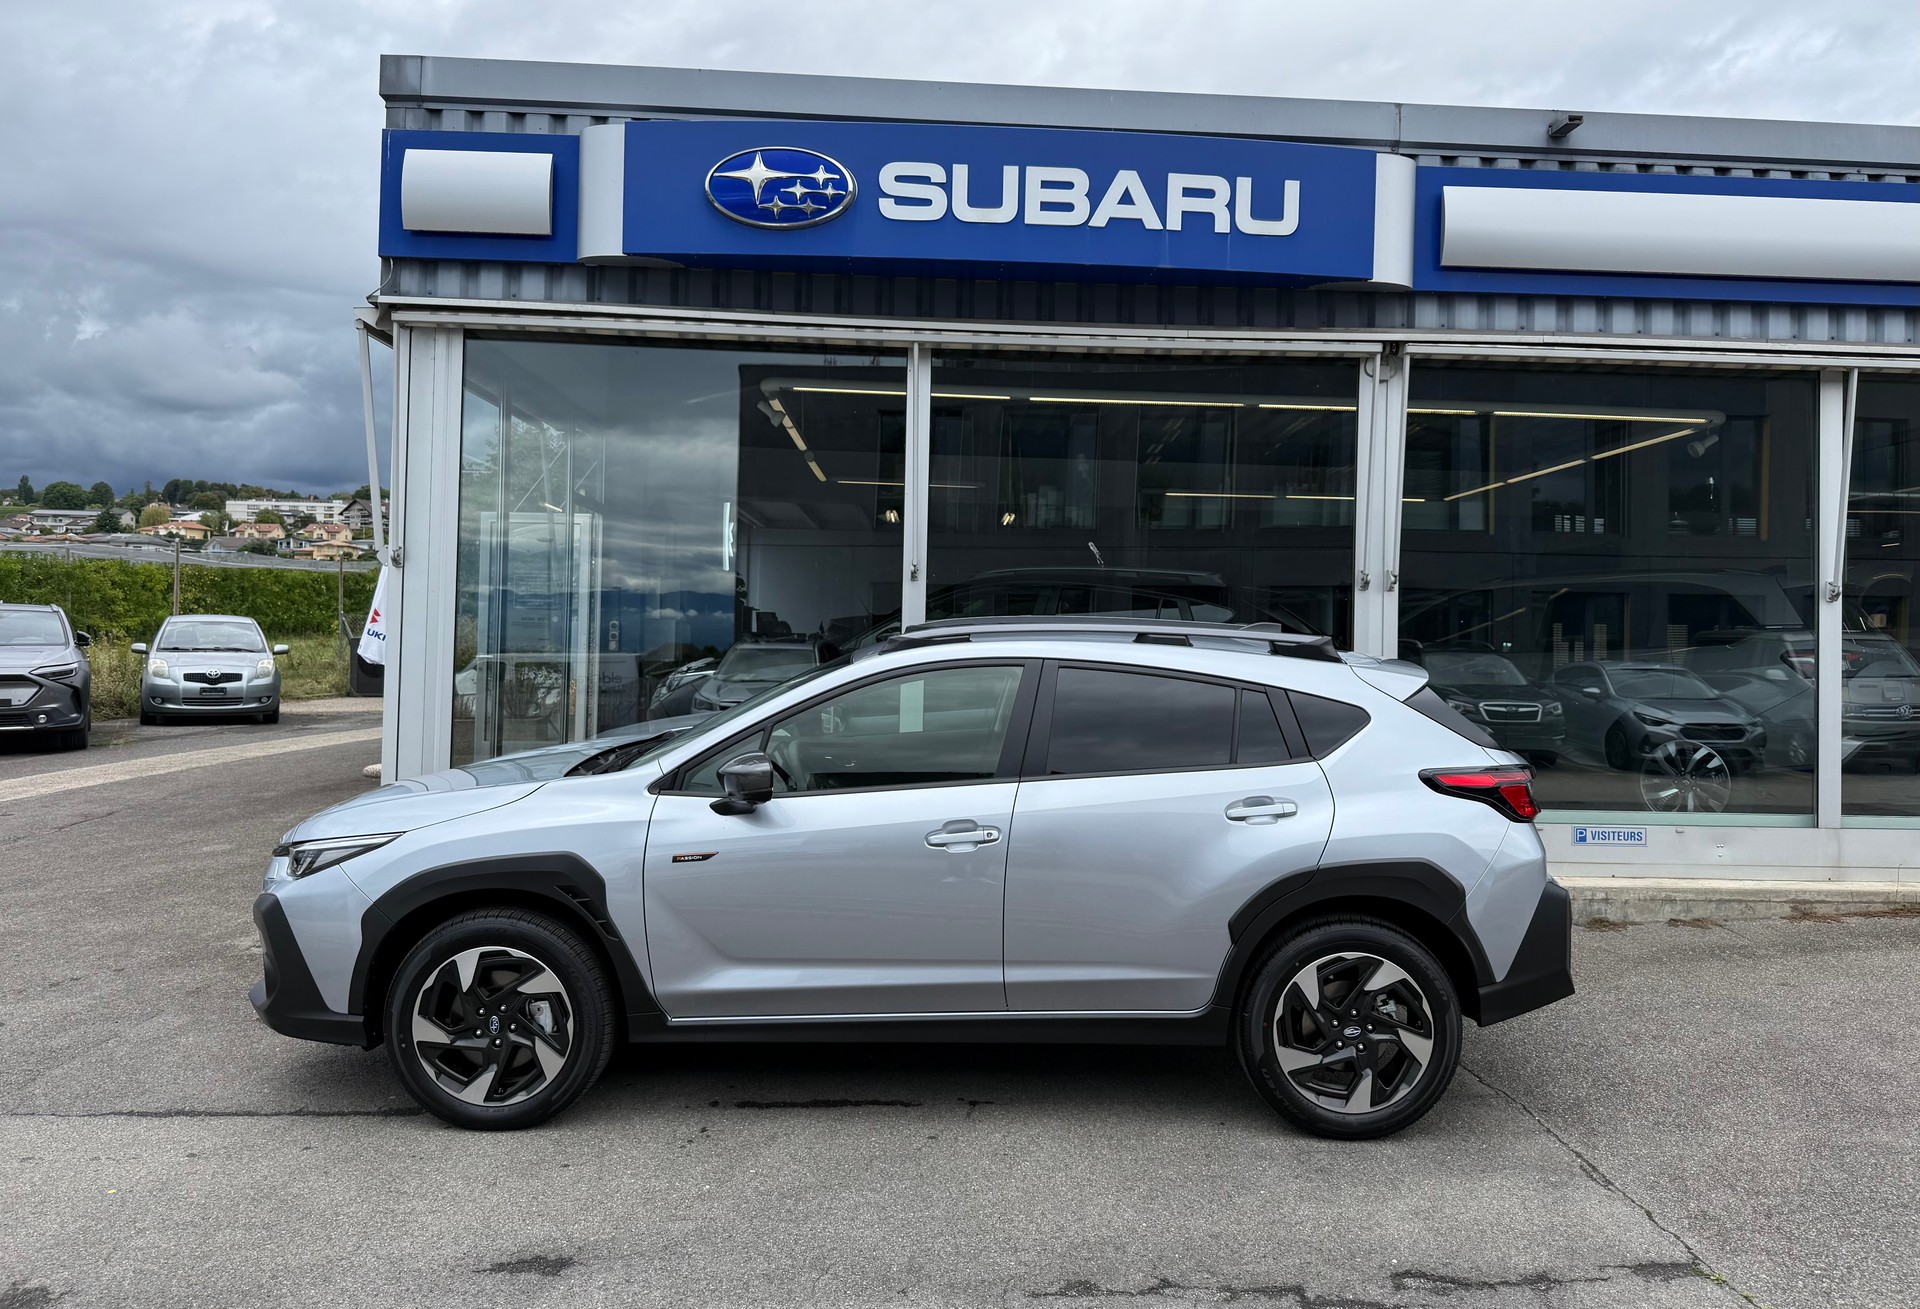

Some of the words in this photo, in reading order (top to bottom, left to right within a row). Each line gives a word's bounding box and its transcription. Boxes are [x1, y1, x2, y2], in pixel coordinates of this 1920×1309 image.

[878, 161, 1301, 236] SUBARU
[1577, 829, 1586, 842] P
[1590, 830, 1643, 842] VISITEURS
